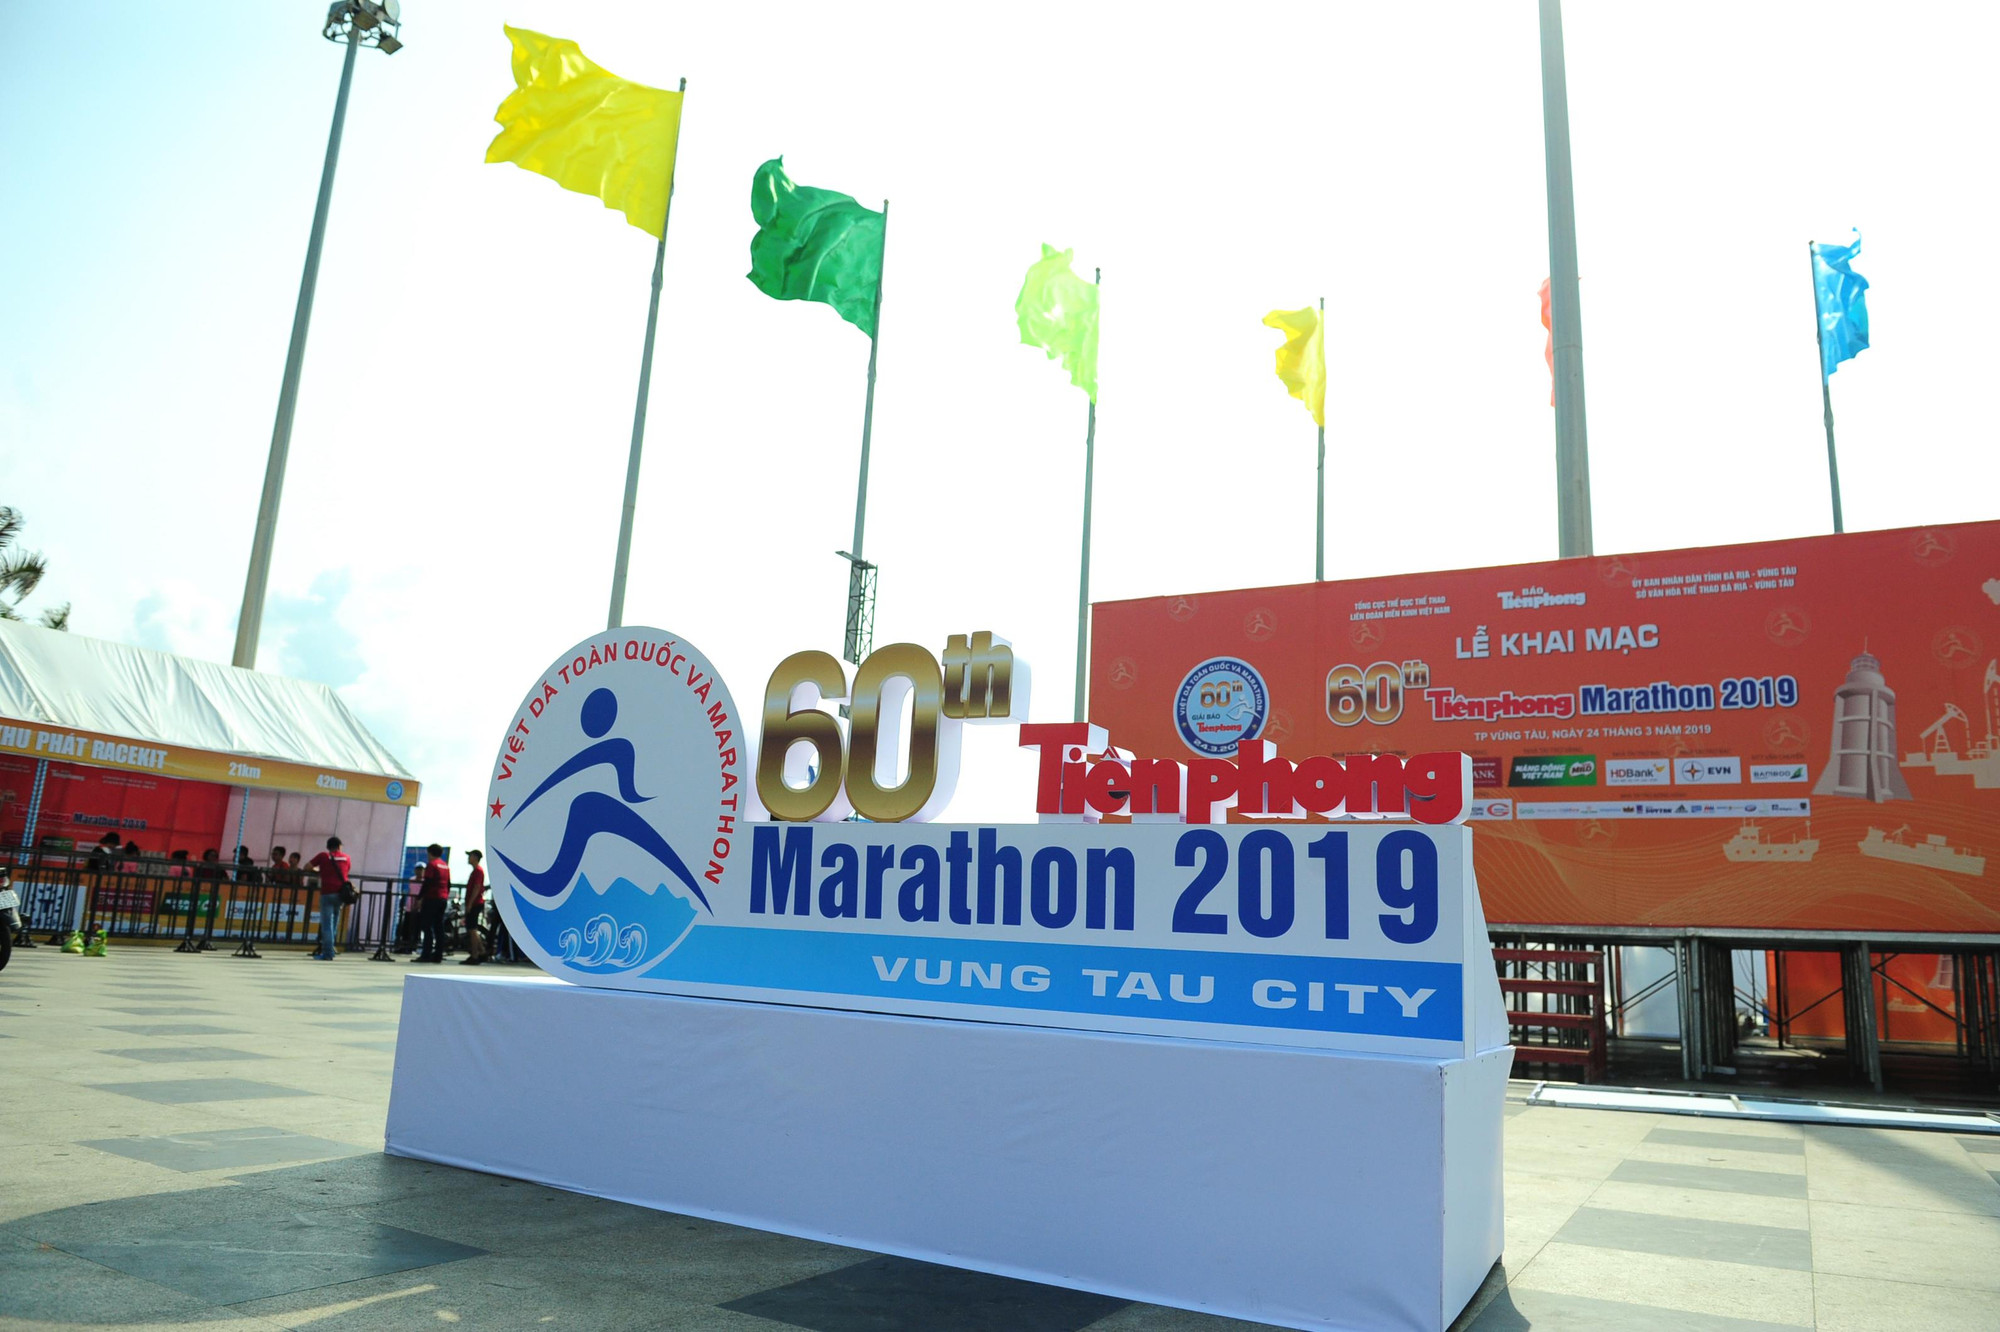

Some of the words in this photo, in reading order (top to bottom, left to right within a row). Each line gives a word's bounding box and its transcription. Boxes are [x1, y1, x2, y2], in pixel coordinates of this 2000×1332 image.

[1456, 625, 1490, 659] LỄ
[1501, 629, 1575, 657] KHAI
[1585, 624, 1659, 655] MẠC
[1580, 682, 1714, 715] Marathon
[1720, 675, 1798, 709] 2019
[0, 725, 31, 749] HU
[35, 733, 88, 757] PHÁT
[91, 740, 168, 769] RACEKIT
[1474, 732, 1488, 741] TP
[1552, 727, 1583, 739] NGÀY
[1587, 728, 1600, 738] 24
[1603, 726, 1642, 737] THÁNG
[1645, 727, 1652, 736] 3
[1684, 725, 1711, 735] 2019
[228, 762, 261, 779] 21km
[497, 718, 530, 781] VIỆT
[529, 682, 558, 718] DÃ
[558, 643, 617, 685] TOÀN
[624, 640, 686, 676] QUỐC
[686, 664, 714, 704] VÀ
[704, 700, 738, 885] MARATHON
[1611, 768, 1654, 778] HDBank
[1708, 766, 1731, 775] EVN
[316, 774, 347, 791] 42km
[750, 826, 1136, 931] Marathon
[1172, 828, 1439, 944] 2019
[872, 955, 1051, 993] VUNG
[1082, 968, 1215, 1004] TAU
[1252, 978, 1437, 1018] CITY
